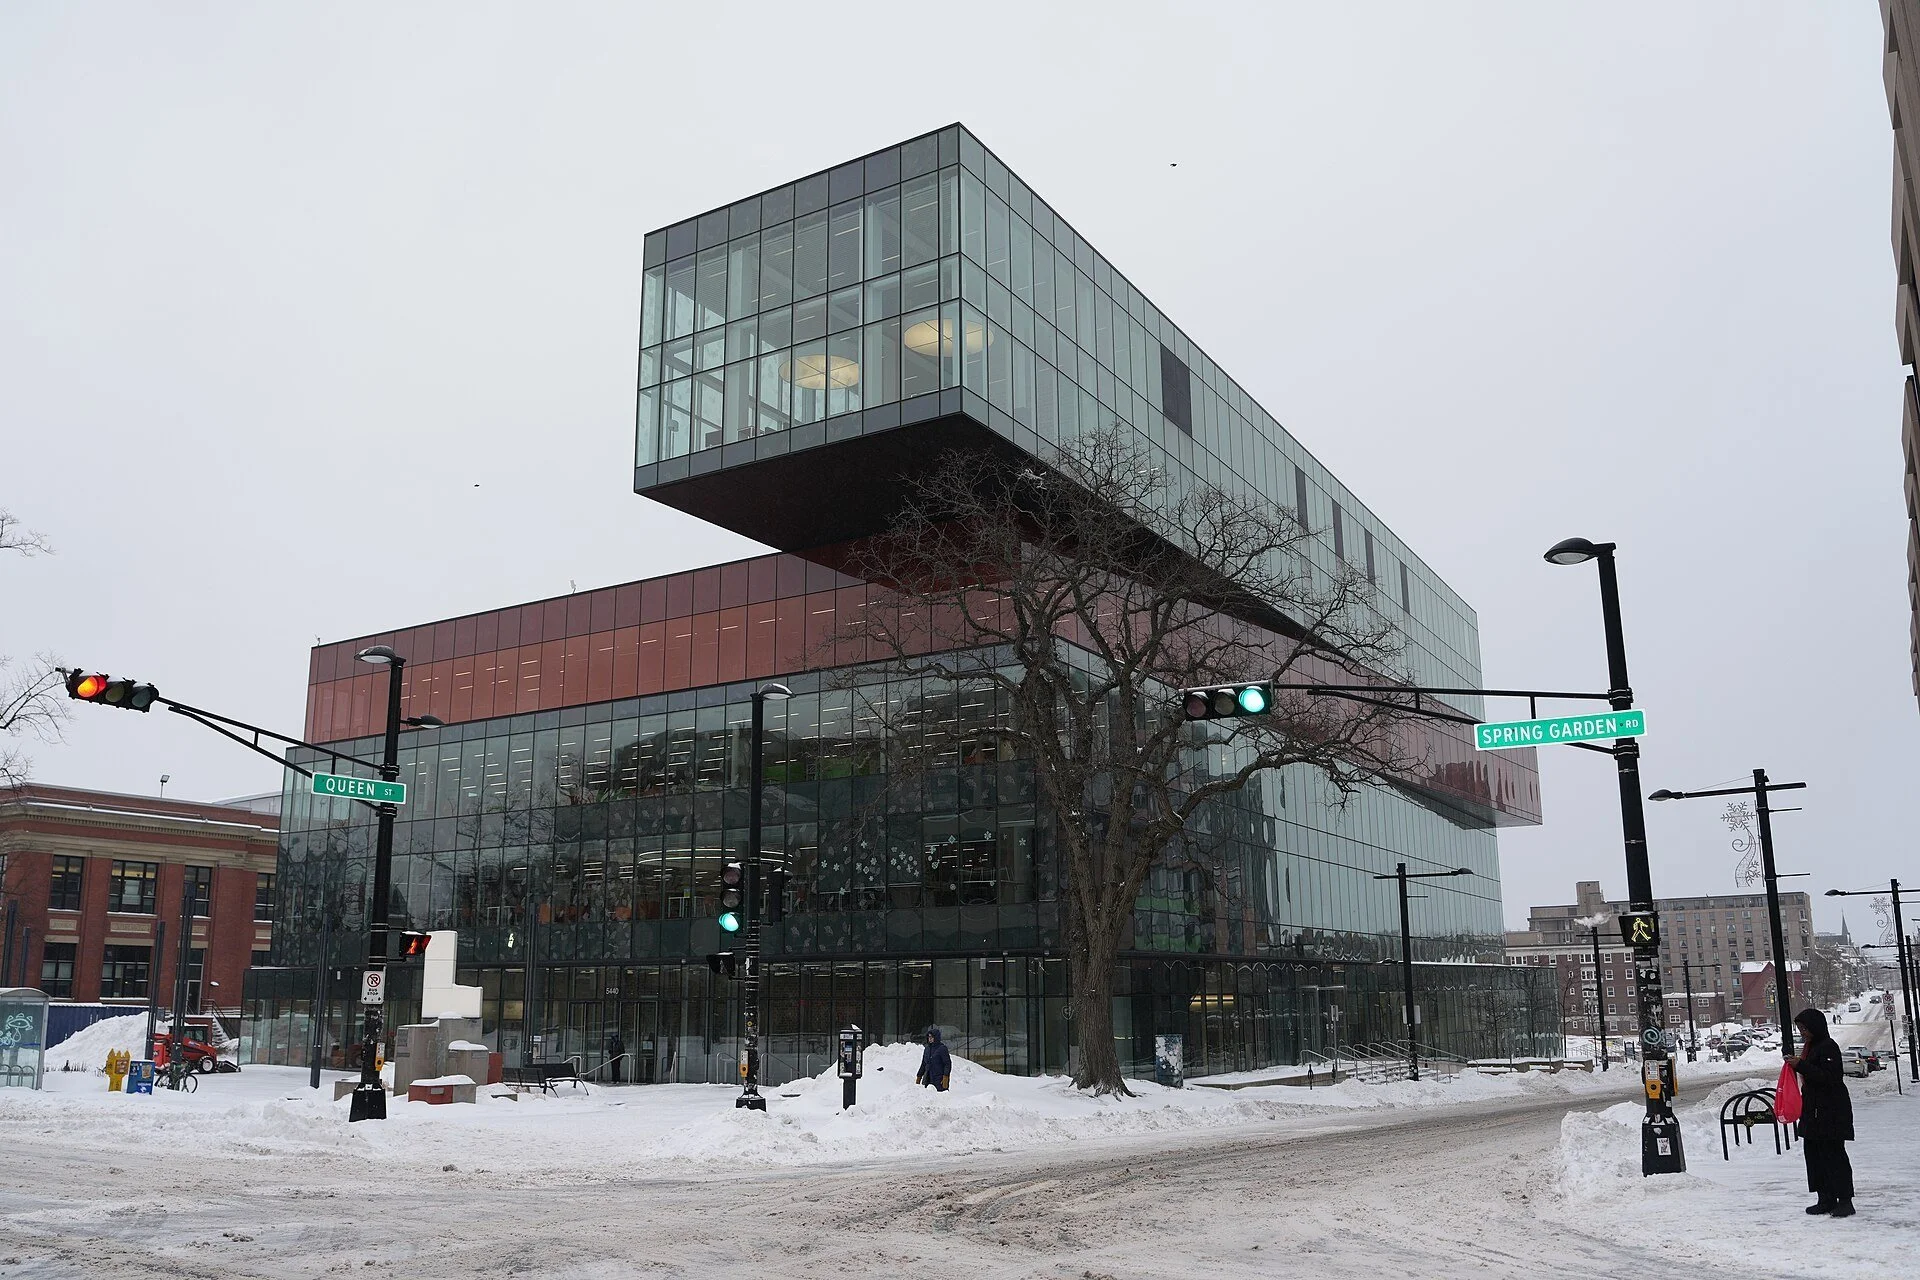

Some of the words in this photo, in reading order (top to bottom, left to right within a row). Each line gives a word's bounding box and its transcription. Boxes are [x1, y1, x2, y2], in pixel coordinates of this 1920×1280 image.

[1482, 725, 1543, 744] SPRING
[1549, 718, 1617, 739] GARDEN
[1625, 719, 1639, 729] RD
[326, 778, 375, 796] QUEEN
[384, 788, 393, 796] ST
[605, 987, 619, 995] 5440
